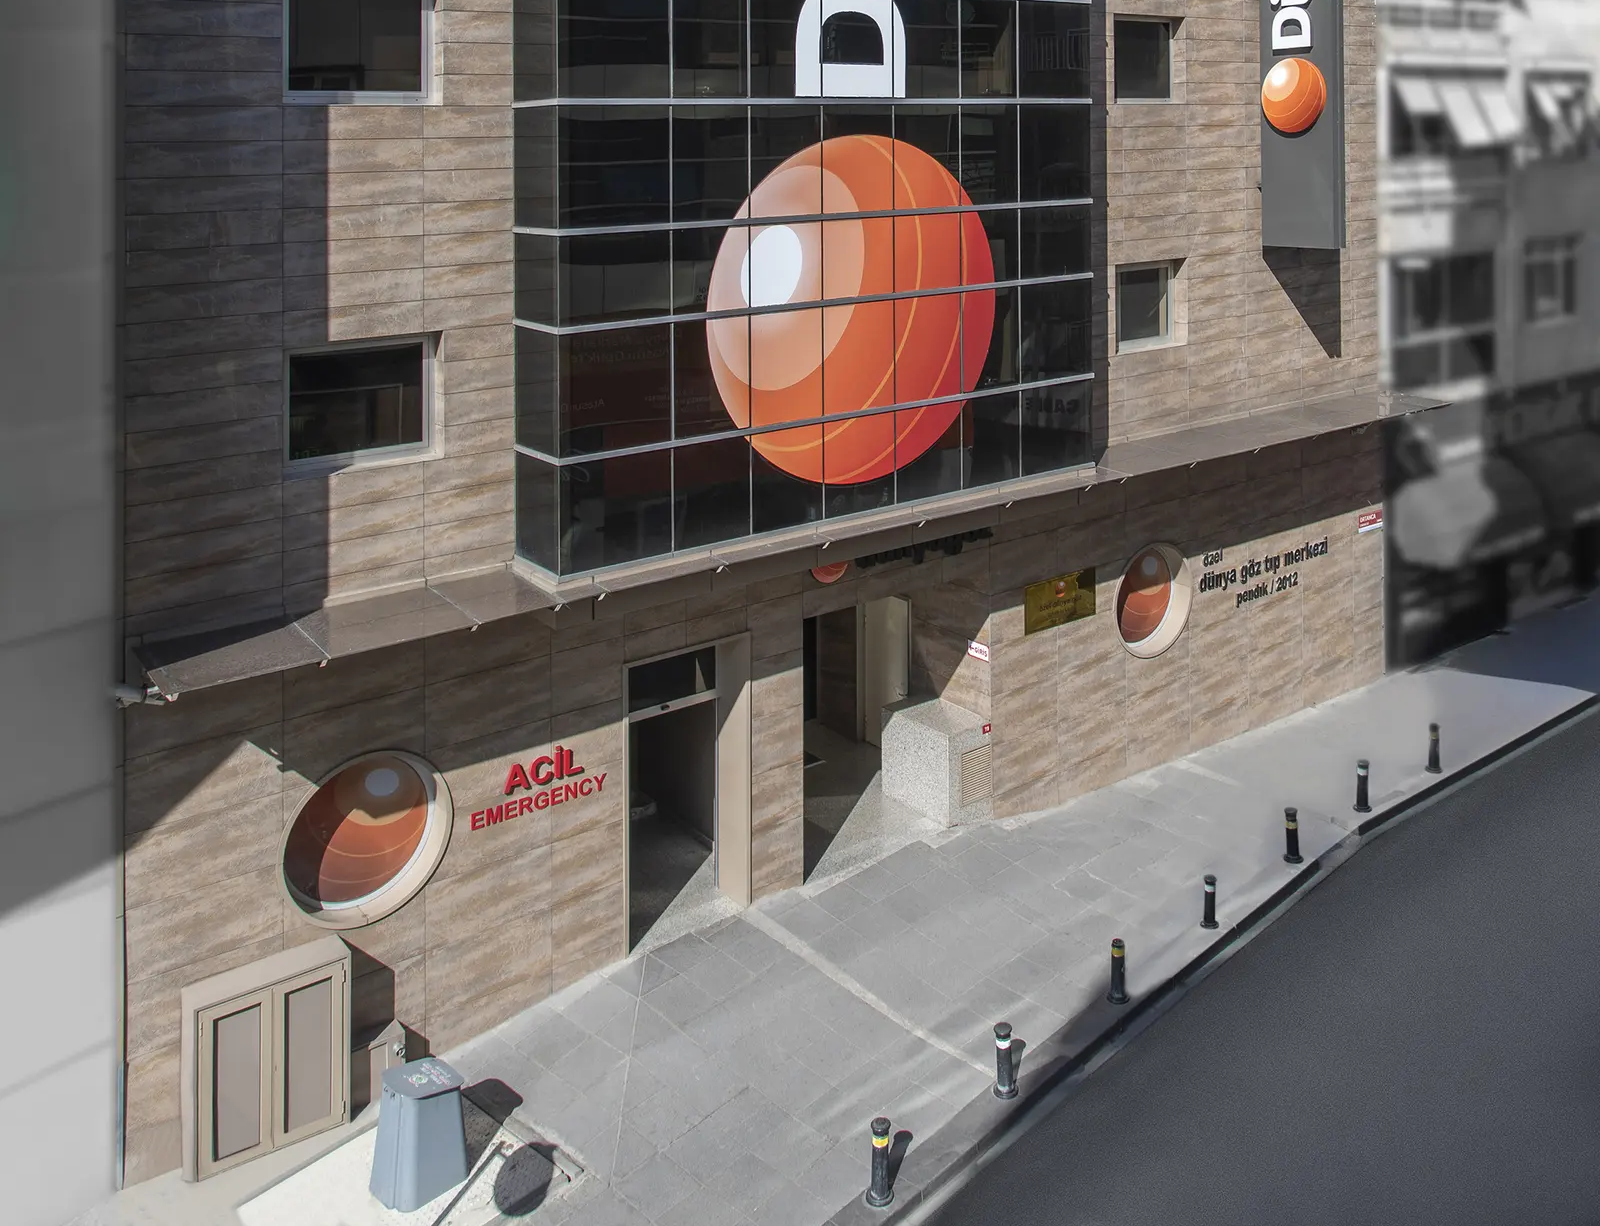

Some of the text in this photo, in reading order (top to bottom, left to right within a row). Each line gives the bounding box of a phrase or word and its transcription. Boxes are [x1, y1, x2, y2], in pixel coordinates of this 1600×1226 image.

[1199, 569, 1237, 593] dünya
[1240, 559, 1262, 584] göz
[1284, 536, 1328, 567] merkezi
[1275, 572, 1298, 592] 2012
[504, 745, 585, 796] ACİL
[469, 773, 608, 831] EMERGENCY
